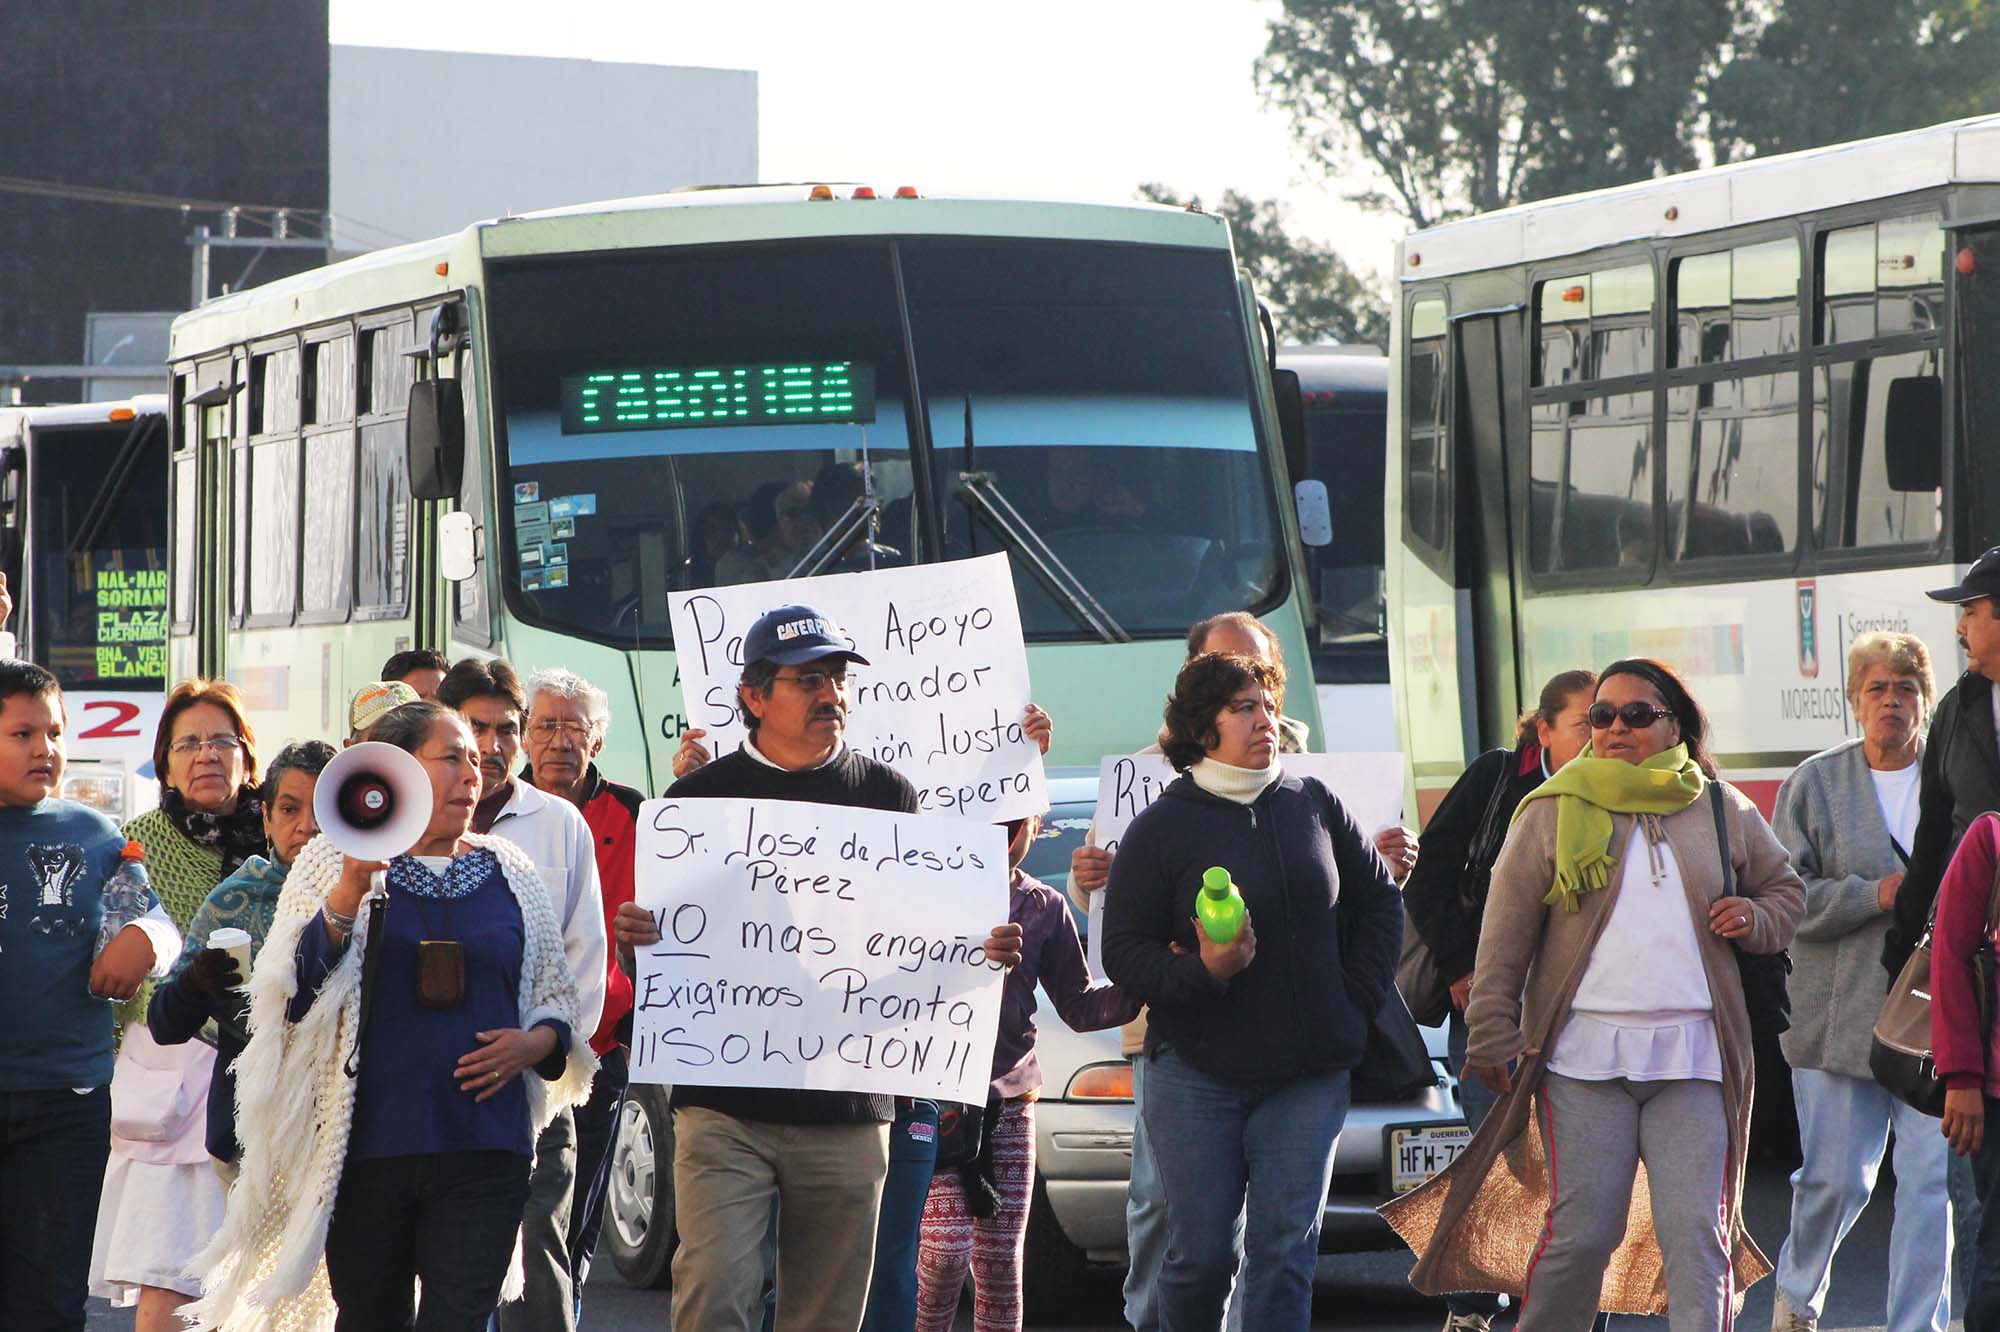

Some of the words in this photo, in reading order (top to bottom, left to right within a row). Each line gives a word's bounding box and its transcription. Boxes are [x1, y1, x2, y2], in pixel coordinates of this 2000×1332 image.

[97, 589, 166, 607] SORIAN
[97, 625, 167, 642] CUERNAVAC
[886, 602, 992, 655] Apoyo
[138, 646, 166, 662] VIST
[78, 701, 141, 739] 2
[1781, 688, 1841, 719] MORELOS
[928, 708, 1025, 765] Justa
[653, 804, 708, 859] Sr.
[725, 806, 820, 865] José
[840, 832, 869, 861] de
[876, 824, 985, 871] Jesús
[746, 860, 855, 901] Pérez
[742, 921, 836, 955] mas
[638, 973, 803, 1019] Exigimos
[819, 967, 974, 1032] Pronta
[1430, 1130, 1470, 1139] GUERRERO
